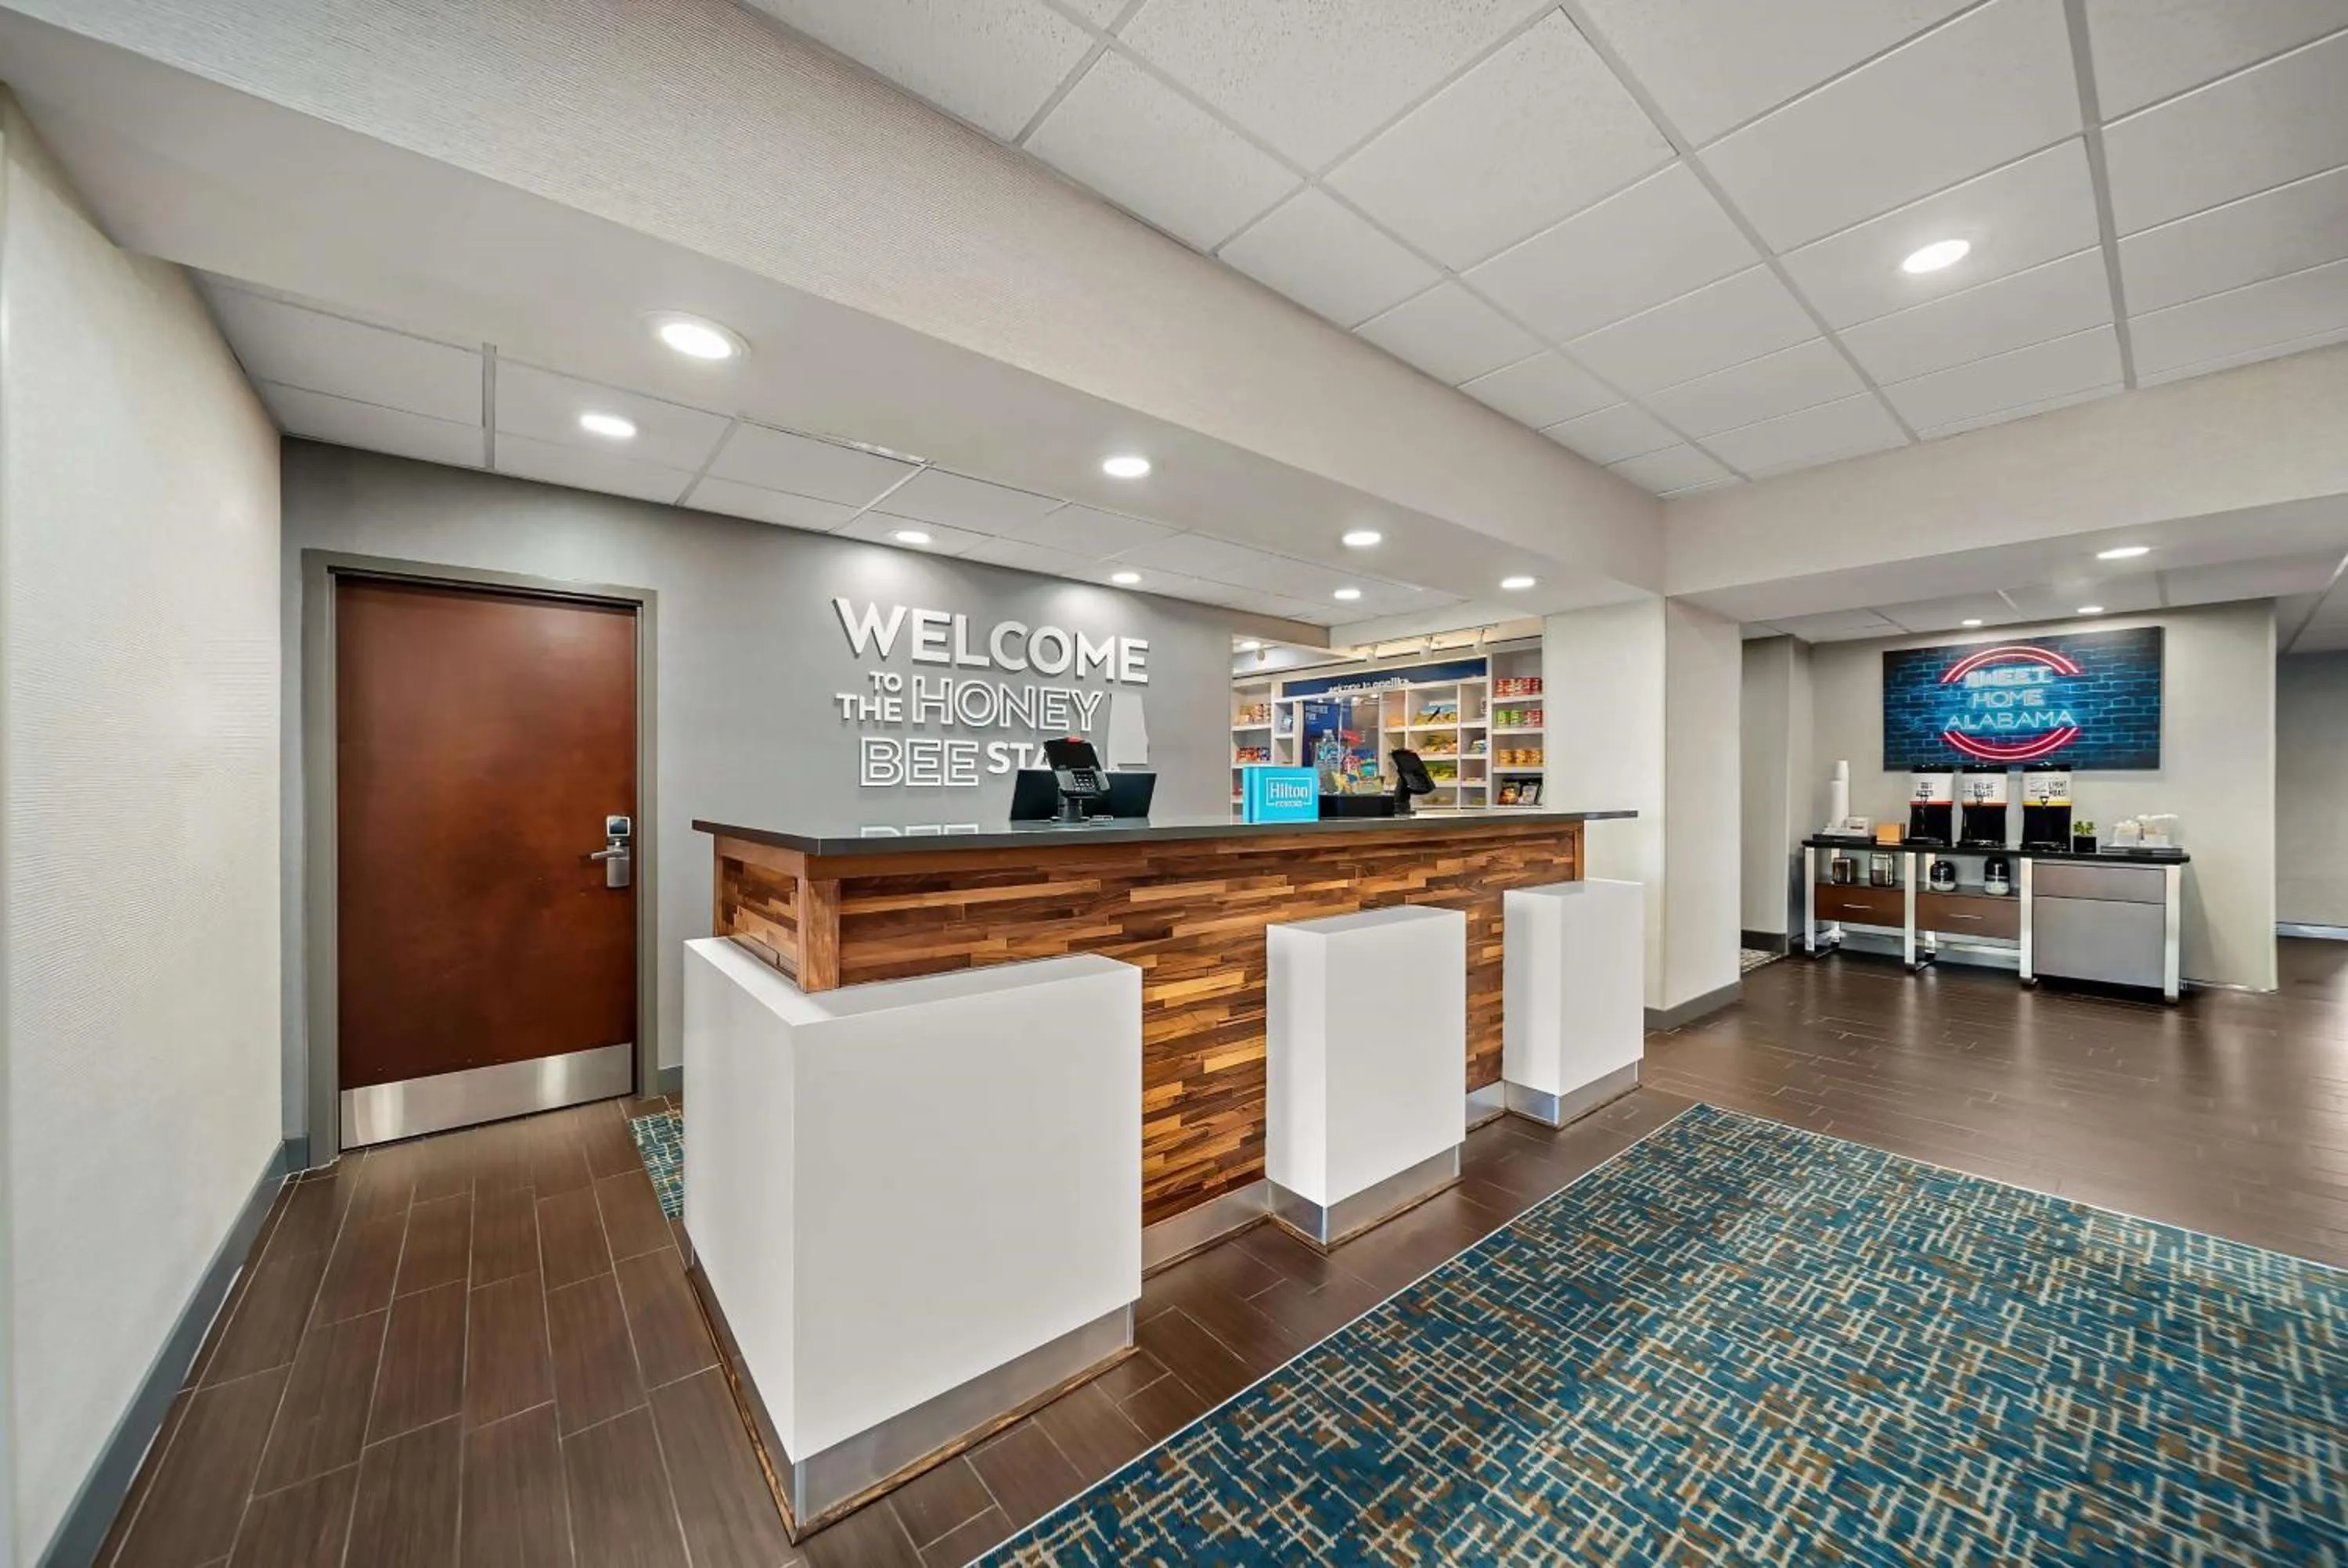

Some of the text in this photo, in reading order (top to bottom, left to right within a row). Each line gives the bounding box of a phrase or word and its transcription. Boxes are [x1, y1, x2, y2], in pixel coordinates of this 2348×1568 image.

[833, 597, 1149, 683] WELCOME
[869, 671, 902, 692] TO
[1964, 666, 2054, 689] SWEET
[834, 674, 1104, 732] THE HONEY
[1972, 689, 2046, 709] HOME
[1944, 710, 2079, 732] ALABAMA
[860, 736, 1053, 787] BEE STA
[1269, 782, 1309, 799] Hilton
